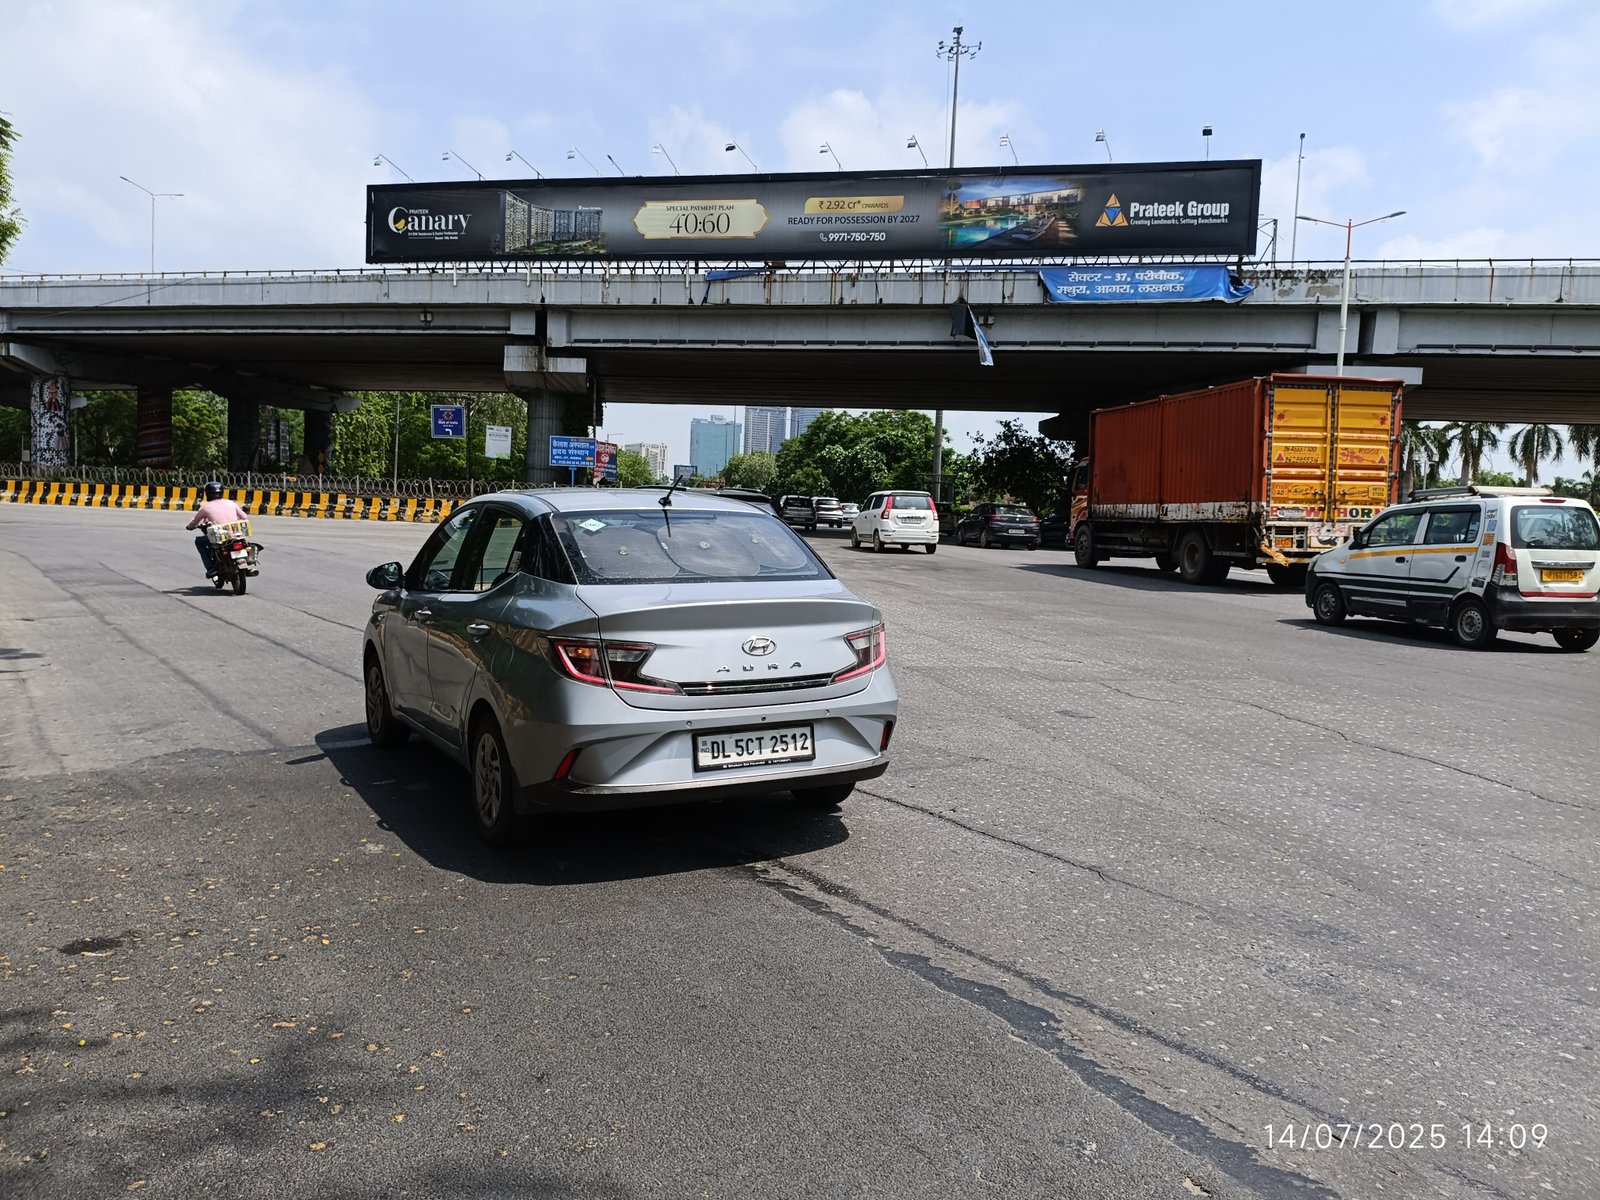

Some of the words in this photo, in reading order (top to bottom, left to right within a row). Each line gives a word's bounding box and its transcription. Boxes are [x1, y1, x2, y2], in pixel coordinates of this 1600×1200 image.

[818, 200, 824, 210] ₹
[826, 200, 845, 210] 2.92
[1129, 201, 1184, 218] Prateek
[1187, 200, 1230, 218] Group
[387, 206, 472, 235] Canary
[669, 212, 731, 235] 40:60
[787, 216, 815, 225] READY
[816, 216, 833, 225] FOR
[834, 215, 886, 225] POSSESSION
[887, 215, 898, 224] BY
[900, 215, 920, 223] 2027
[1130, 218, 1151, 226] Creating
[1151, 217, 1179, 225] Landmarks,
[1180, 217, 1197, 225] Setting
[828, 232, 886, 242] 9971-750-750
[1068, 271, 1102, 282] सेक्टर
[1056, 285, 1091, 297] मथुरा,
[1094, 284, 1135, 294] आगरा,
[1137, 283, 1185, 293] लखनऊ
[716, 661, 802, 673] AURA
[711, 740, 731, 760] DL
[735, 736, 764, 757] 5CT
[770, 732, 809, 754] 2512
